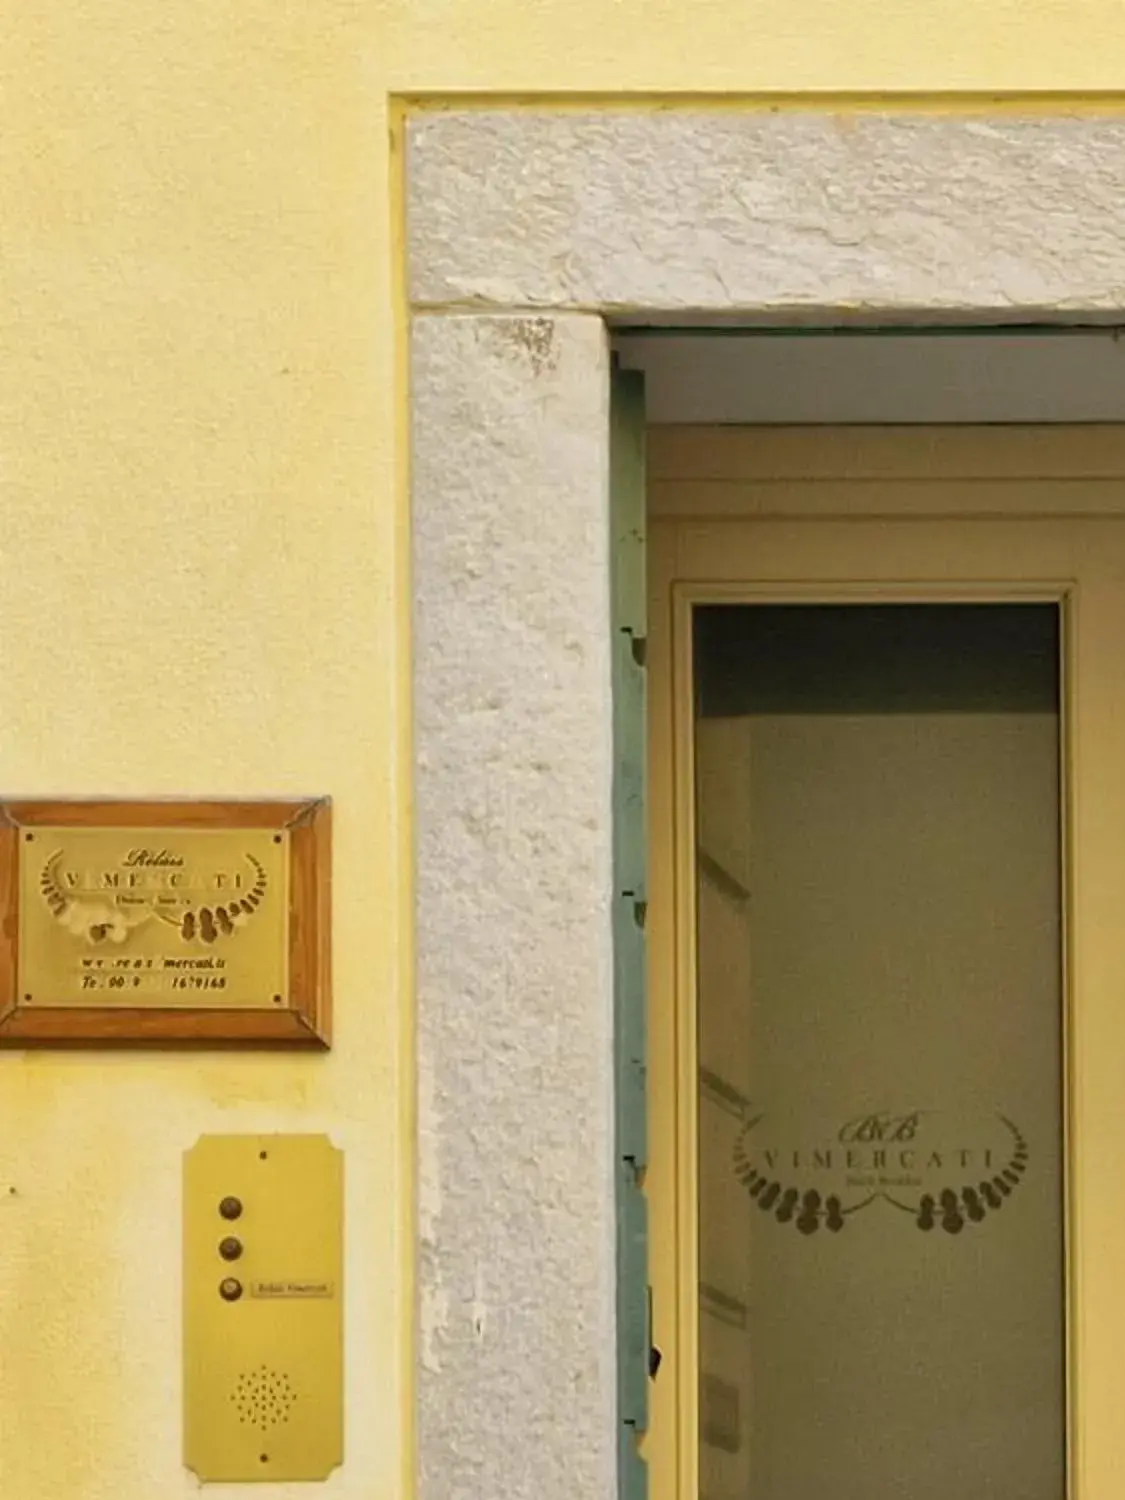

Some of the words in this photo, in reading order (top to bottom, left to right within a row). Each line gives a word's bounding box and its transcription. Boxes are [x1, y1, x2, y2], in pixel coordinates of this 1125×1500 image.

[122, 849, 185, 867] Relais
[65, 872, 242, 888] VMECTI
[82, 975, 104, 989] Te.
[763, 1149, 992, 1170] VIMERCATI
